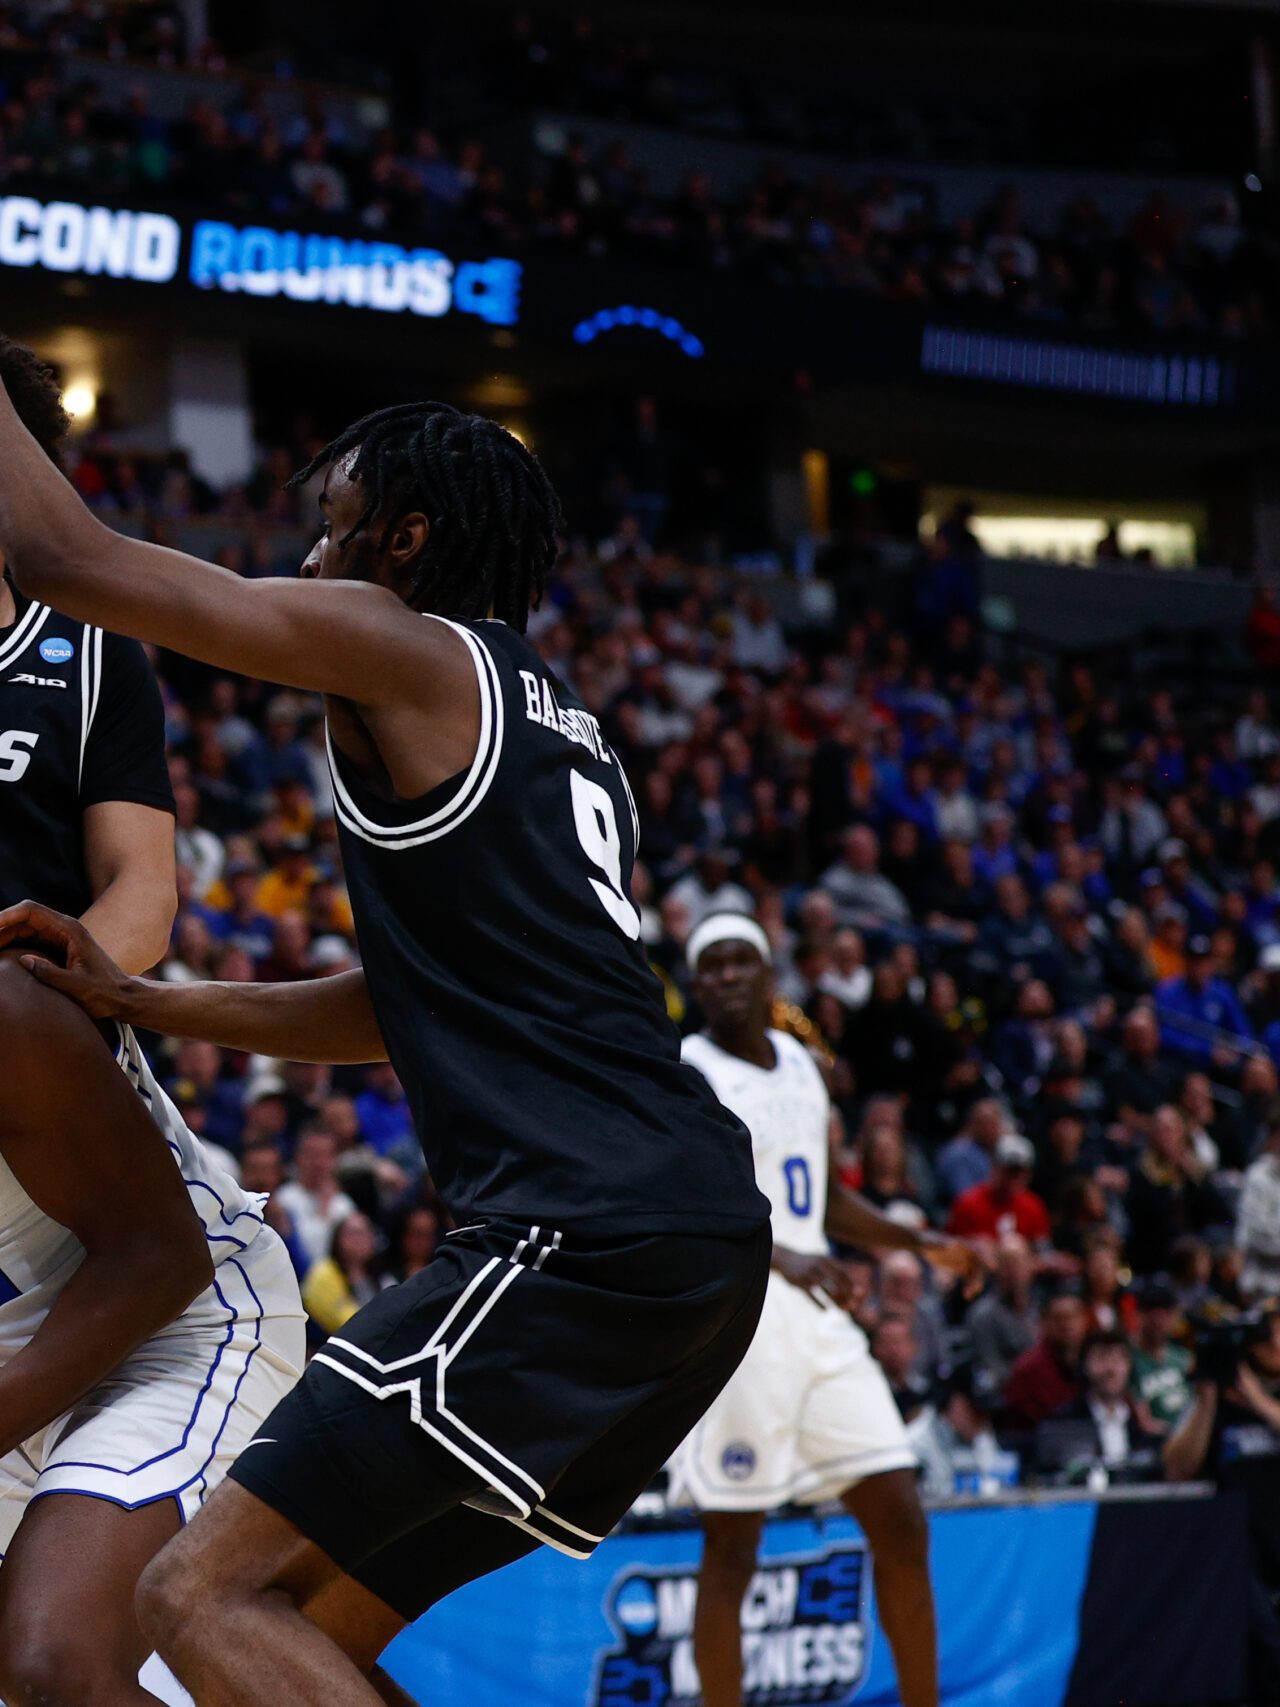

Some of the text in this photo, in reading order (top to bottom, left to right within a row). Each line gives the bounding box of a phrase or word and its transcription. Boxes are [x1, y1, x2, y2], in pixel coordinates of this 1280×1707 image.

[188, 218, 455, 318] ROUNDS
[569, 767, 641, 942] 9
[783, 1157, 812, 1217] 0
